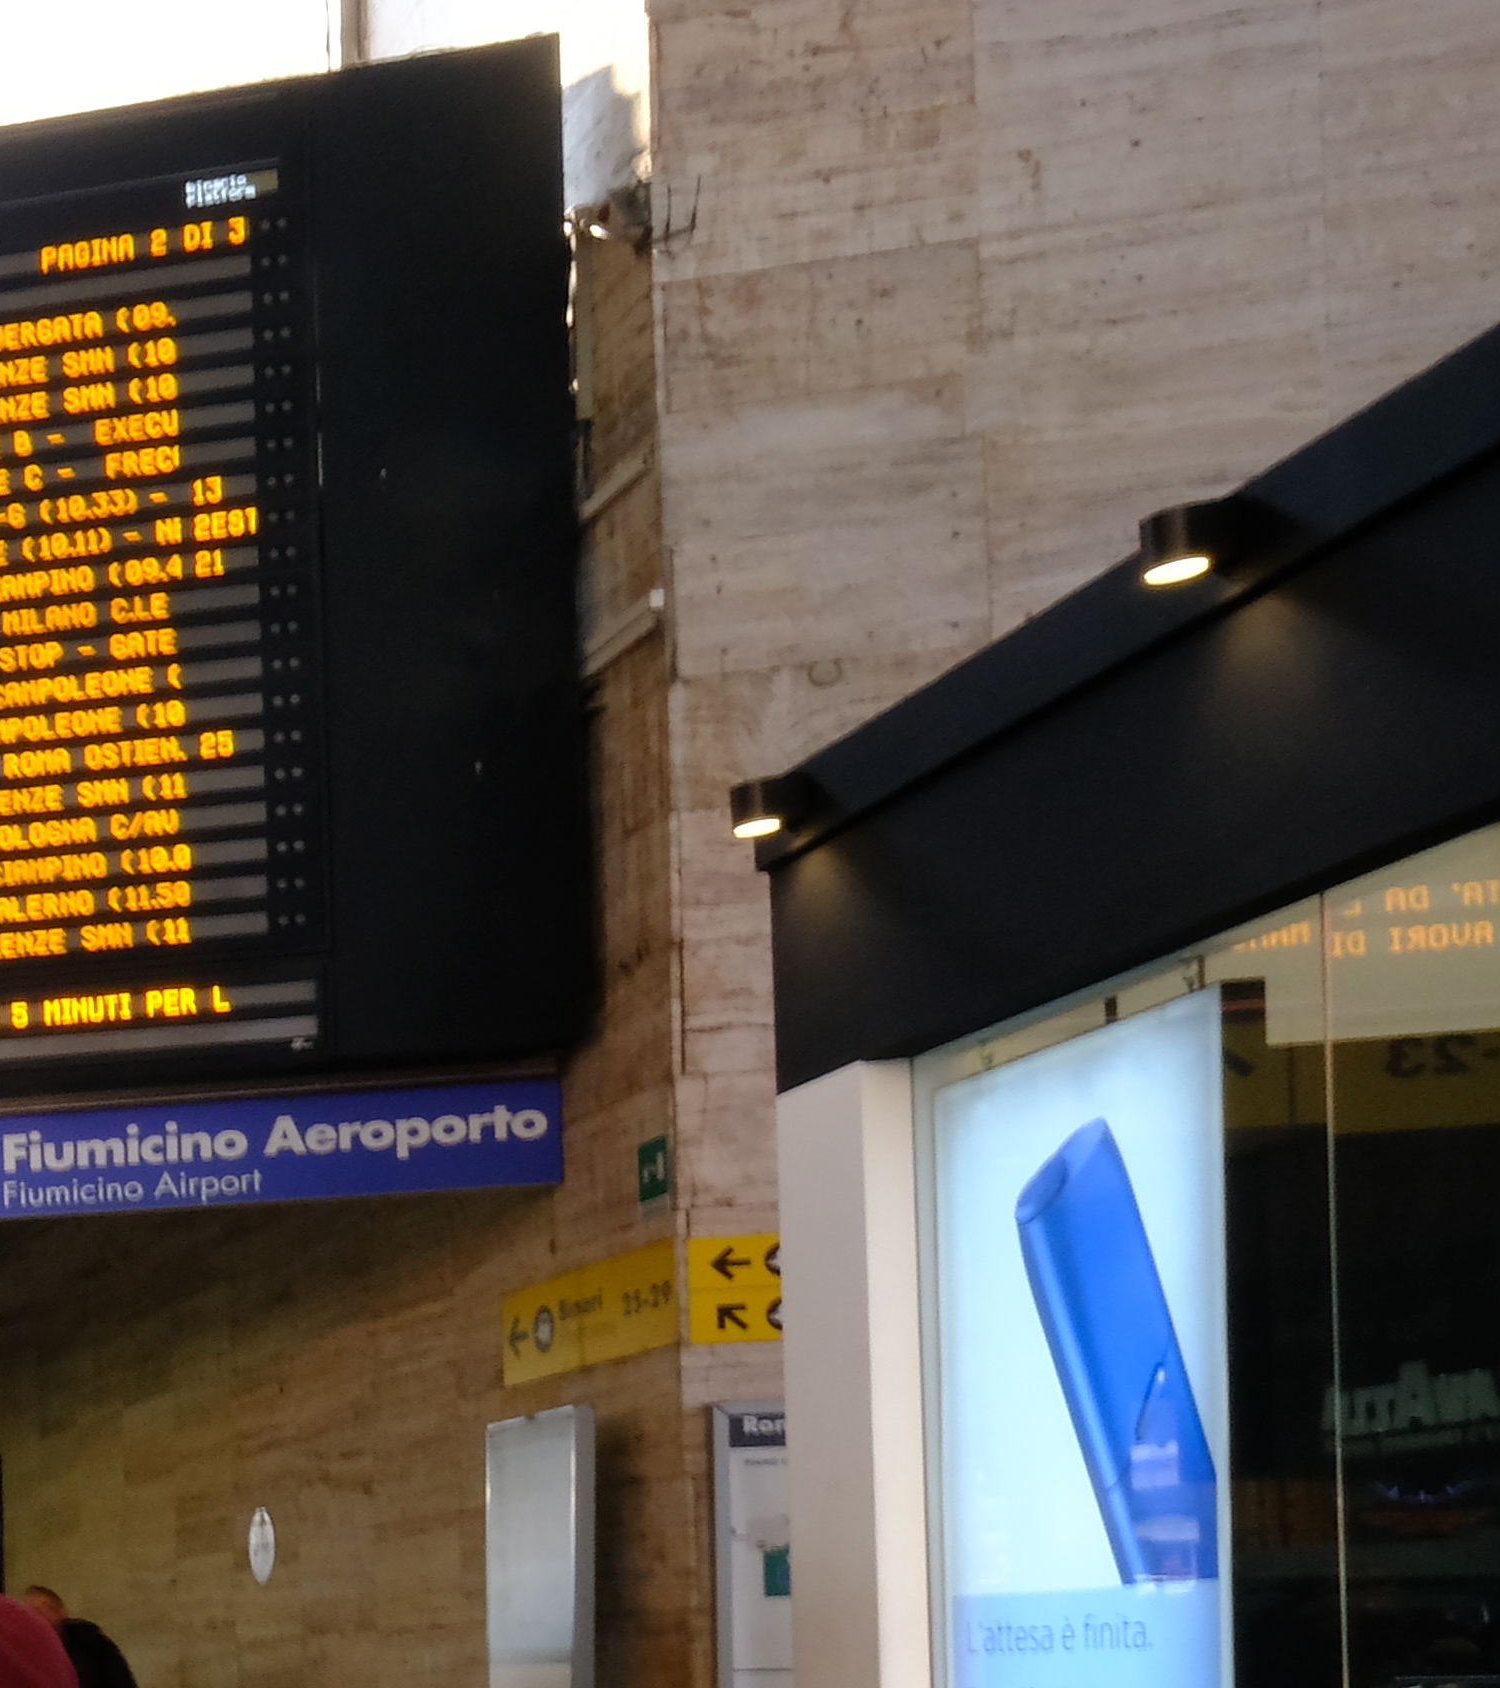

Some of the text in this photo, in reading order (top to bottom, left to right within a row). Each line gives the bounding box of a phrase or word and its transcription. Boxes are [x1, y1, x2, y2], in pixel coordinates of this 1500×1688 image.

[41, 217, 245, 272] PAGINA 2 DI 3
[3, 1105, 549, 1174] Fiumicino Aeroporto
[3, 1168, 263, 1208] Fiumicino Airport
